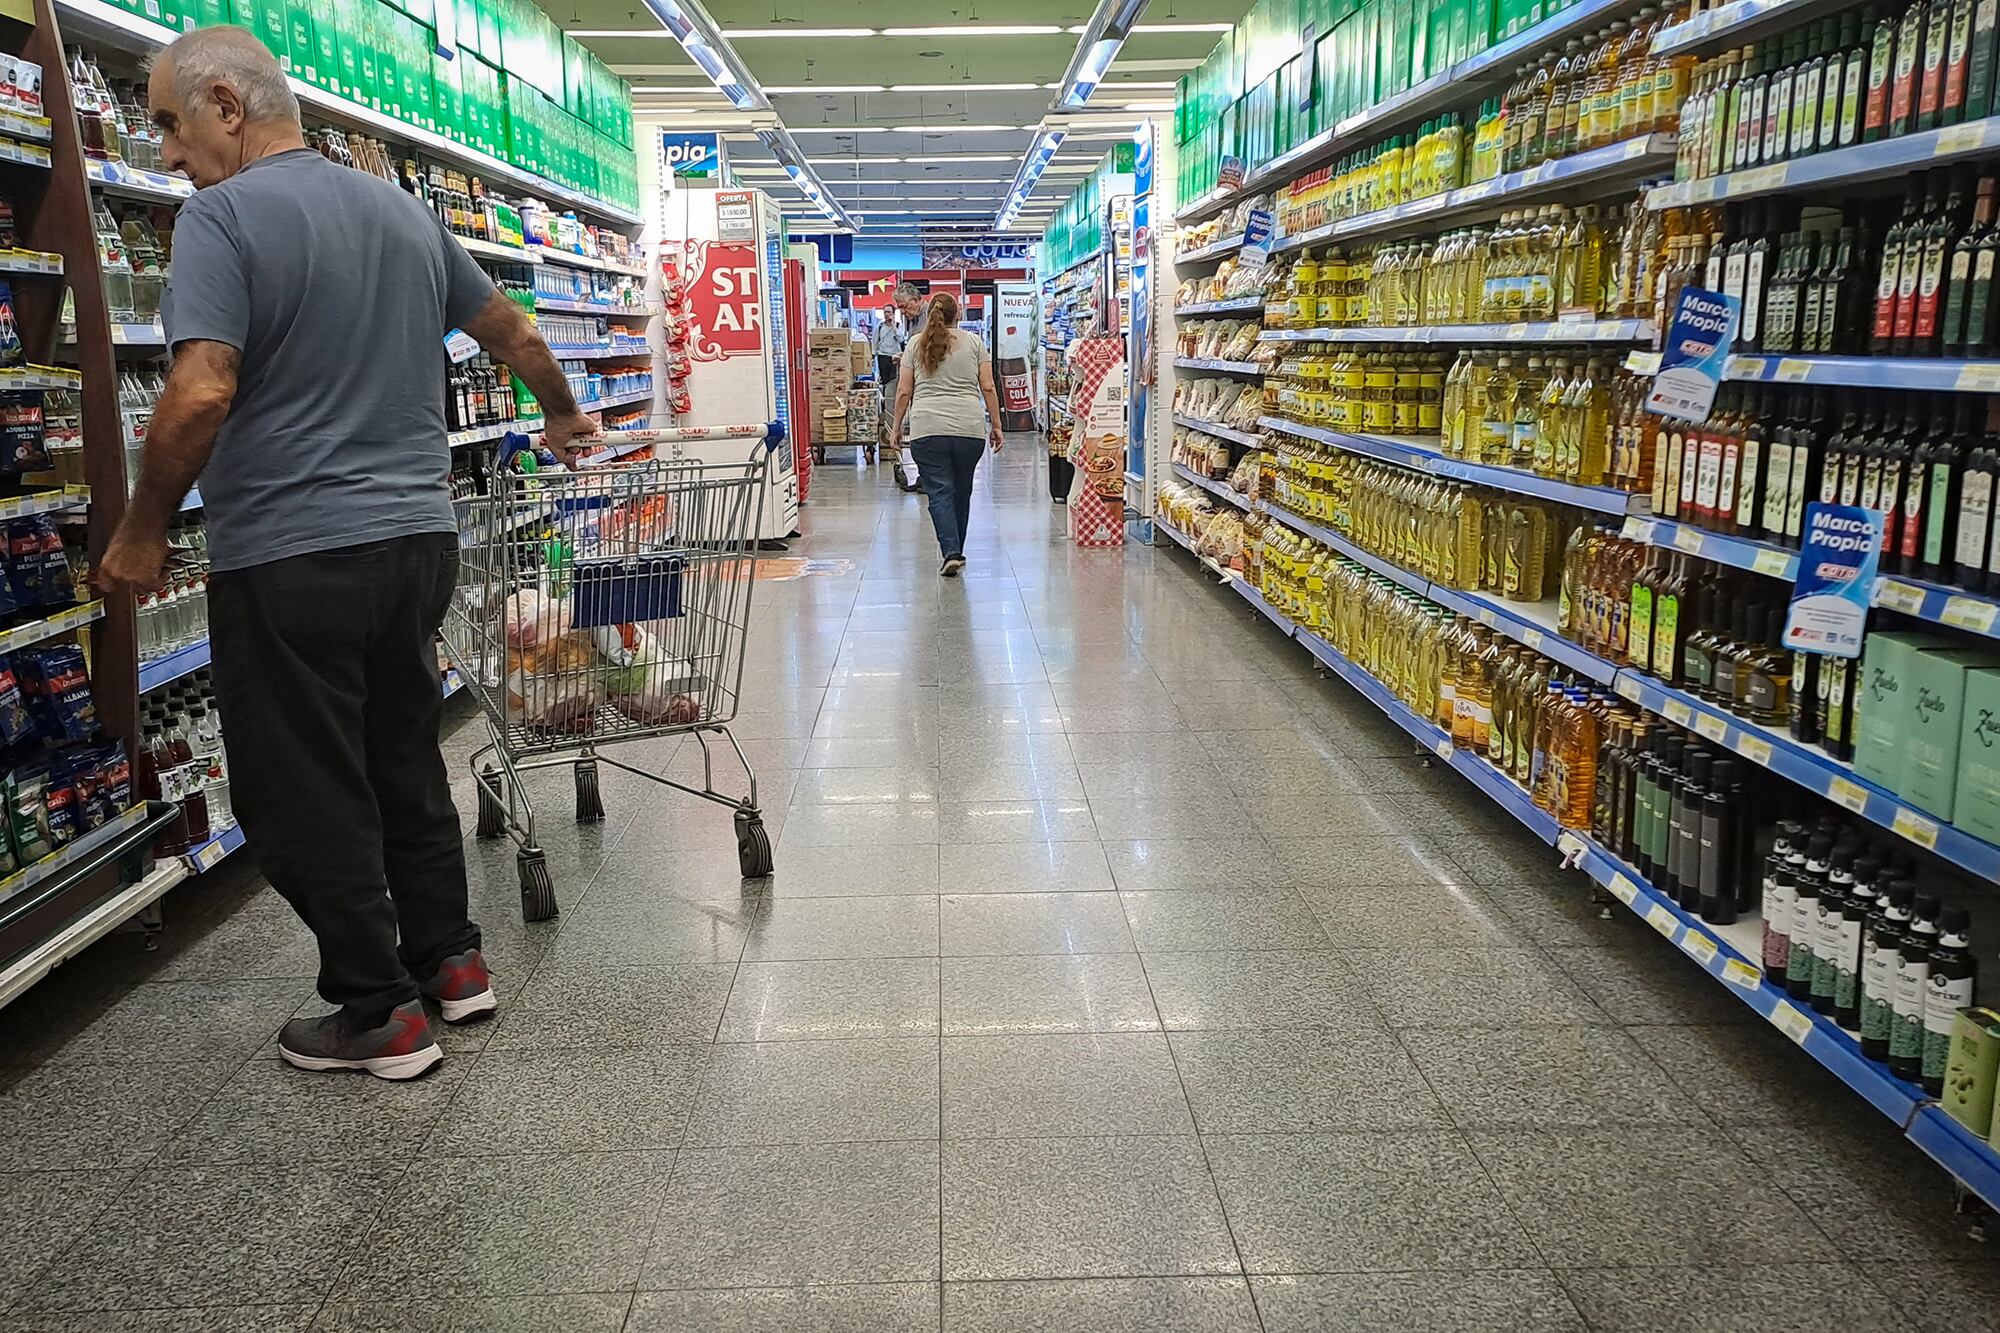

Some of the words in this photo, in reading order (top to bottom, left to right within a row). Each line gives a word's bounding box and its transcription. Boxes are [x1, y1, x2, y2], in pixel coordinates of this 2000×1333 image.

[720, 194, 746, 202] OFERTA
[711, 267, 757, 297] ST
[1004, 299, 1033, 307] NUEVA
[1682, 295, 1733, 319] Marca
[1679, 310, 1729, 333] Propia
[1009, 387, 1031, 400] COLA
[727, 424, 756, 432] COTO
[1811, 512, 1875, 535] Marca
[1809, 529, 1873, 552] Propia
